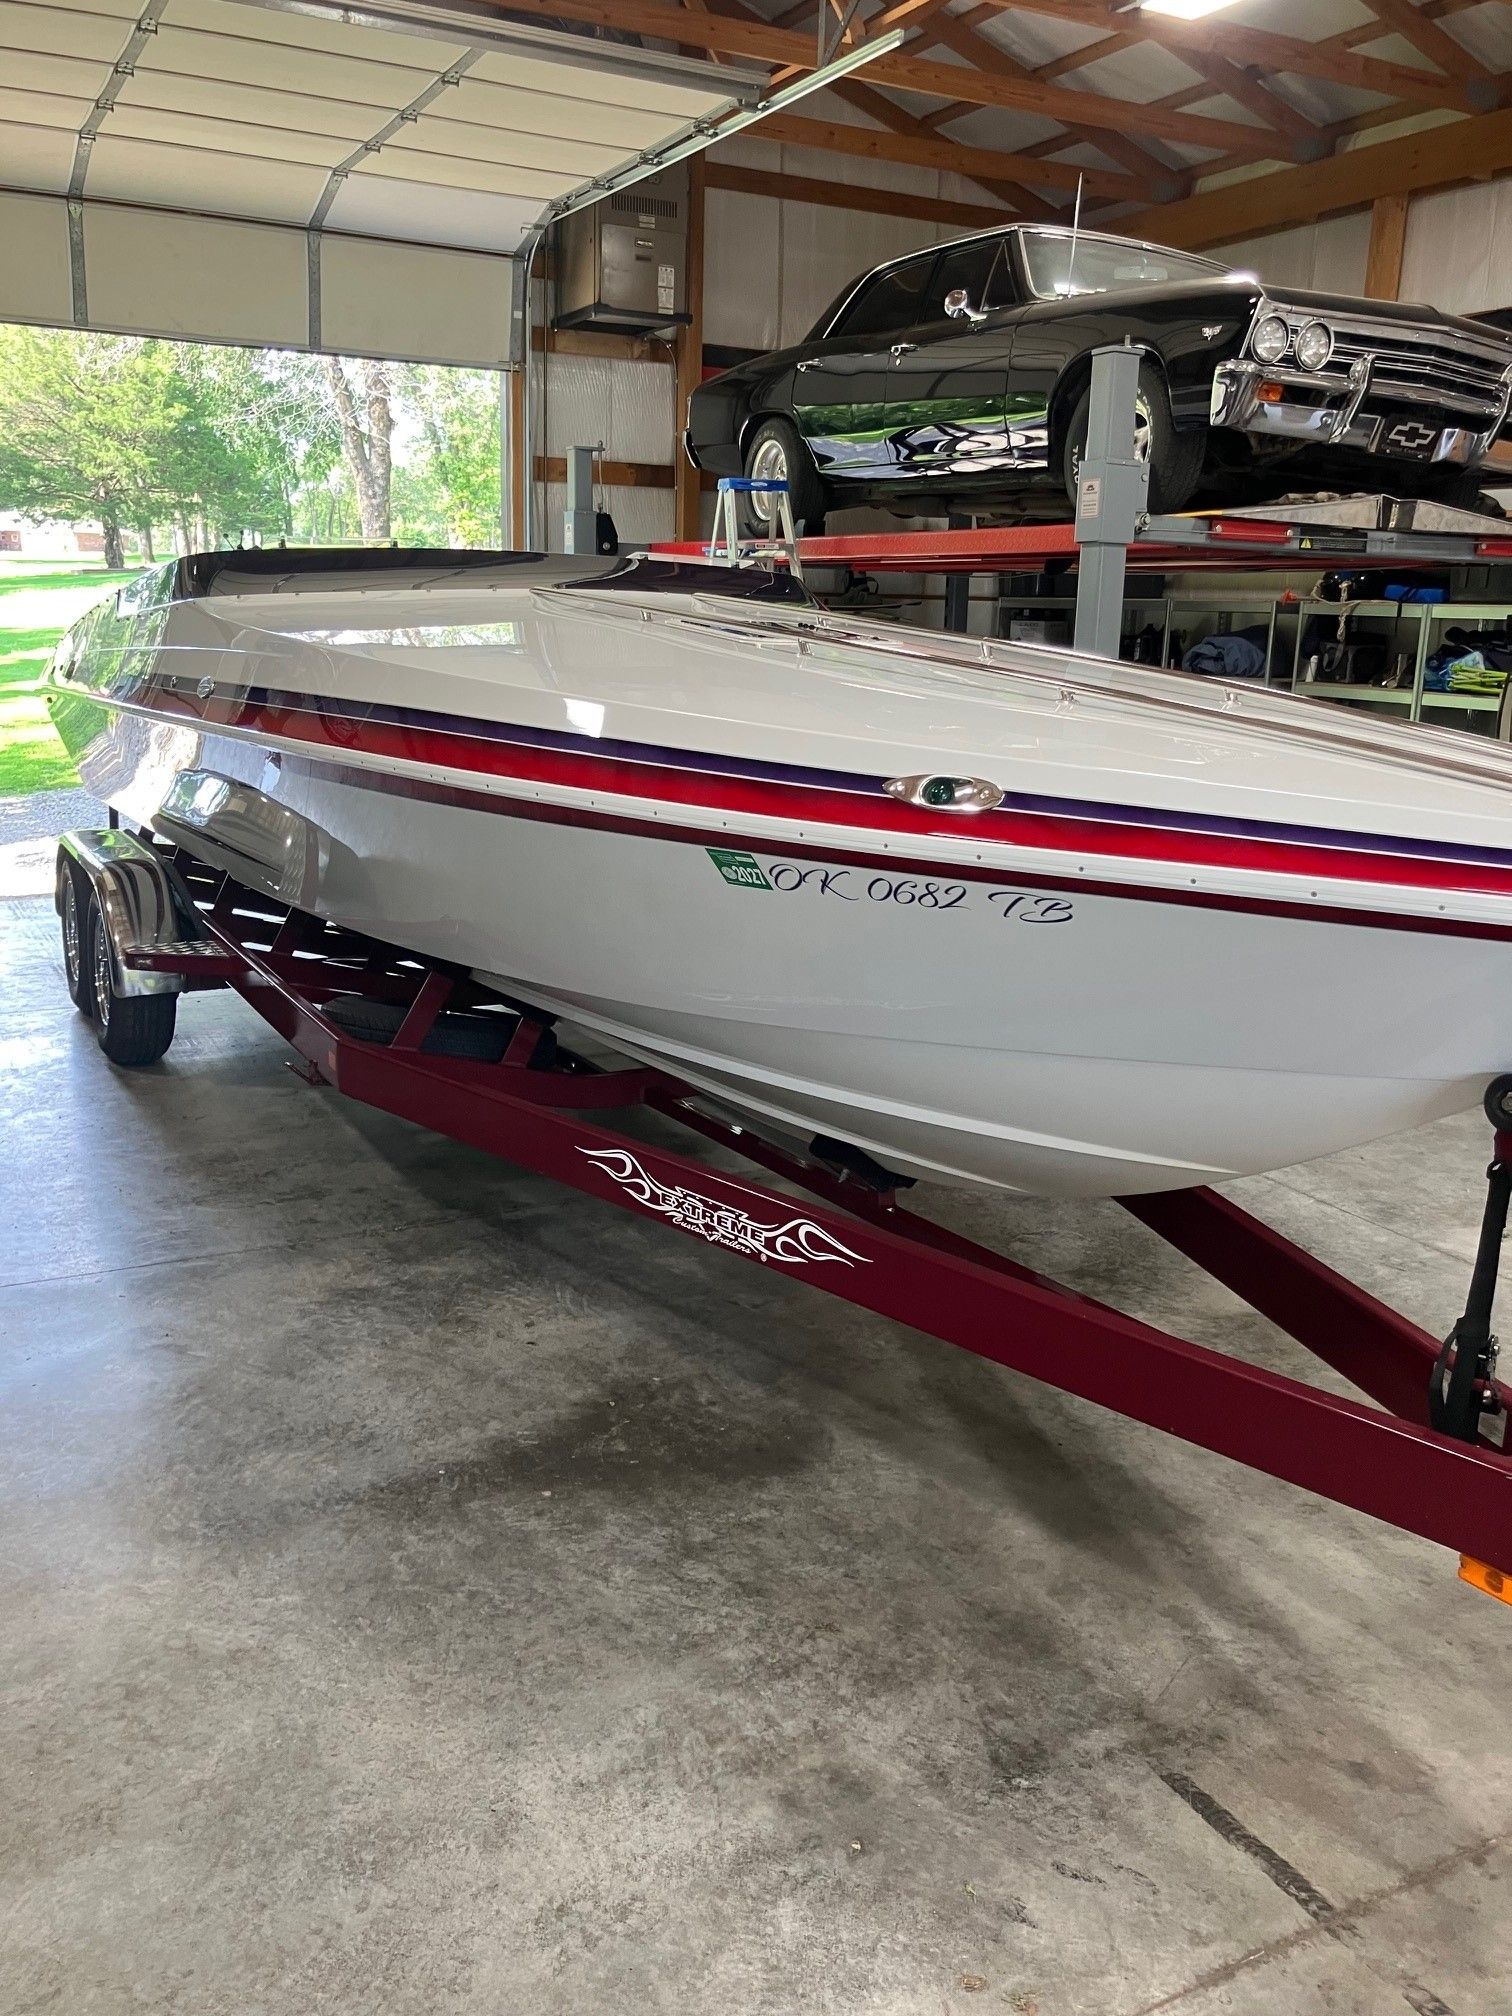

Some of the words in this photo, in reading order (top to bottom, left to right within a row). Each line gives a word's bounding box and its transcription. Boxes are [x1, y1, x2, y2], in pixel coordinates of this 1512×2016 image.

[731, 865, 767, 885] 2027
[769, 863, 859, 901] OK
[867, 877, 971, 909] 0682
[988, 891, 1073, 923] TB
[660, 1191, 765, 1246] EXTREME
[706, 1231, 752, 1254] Trailers
